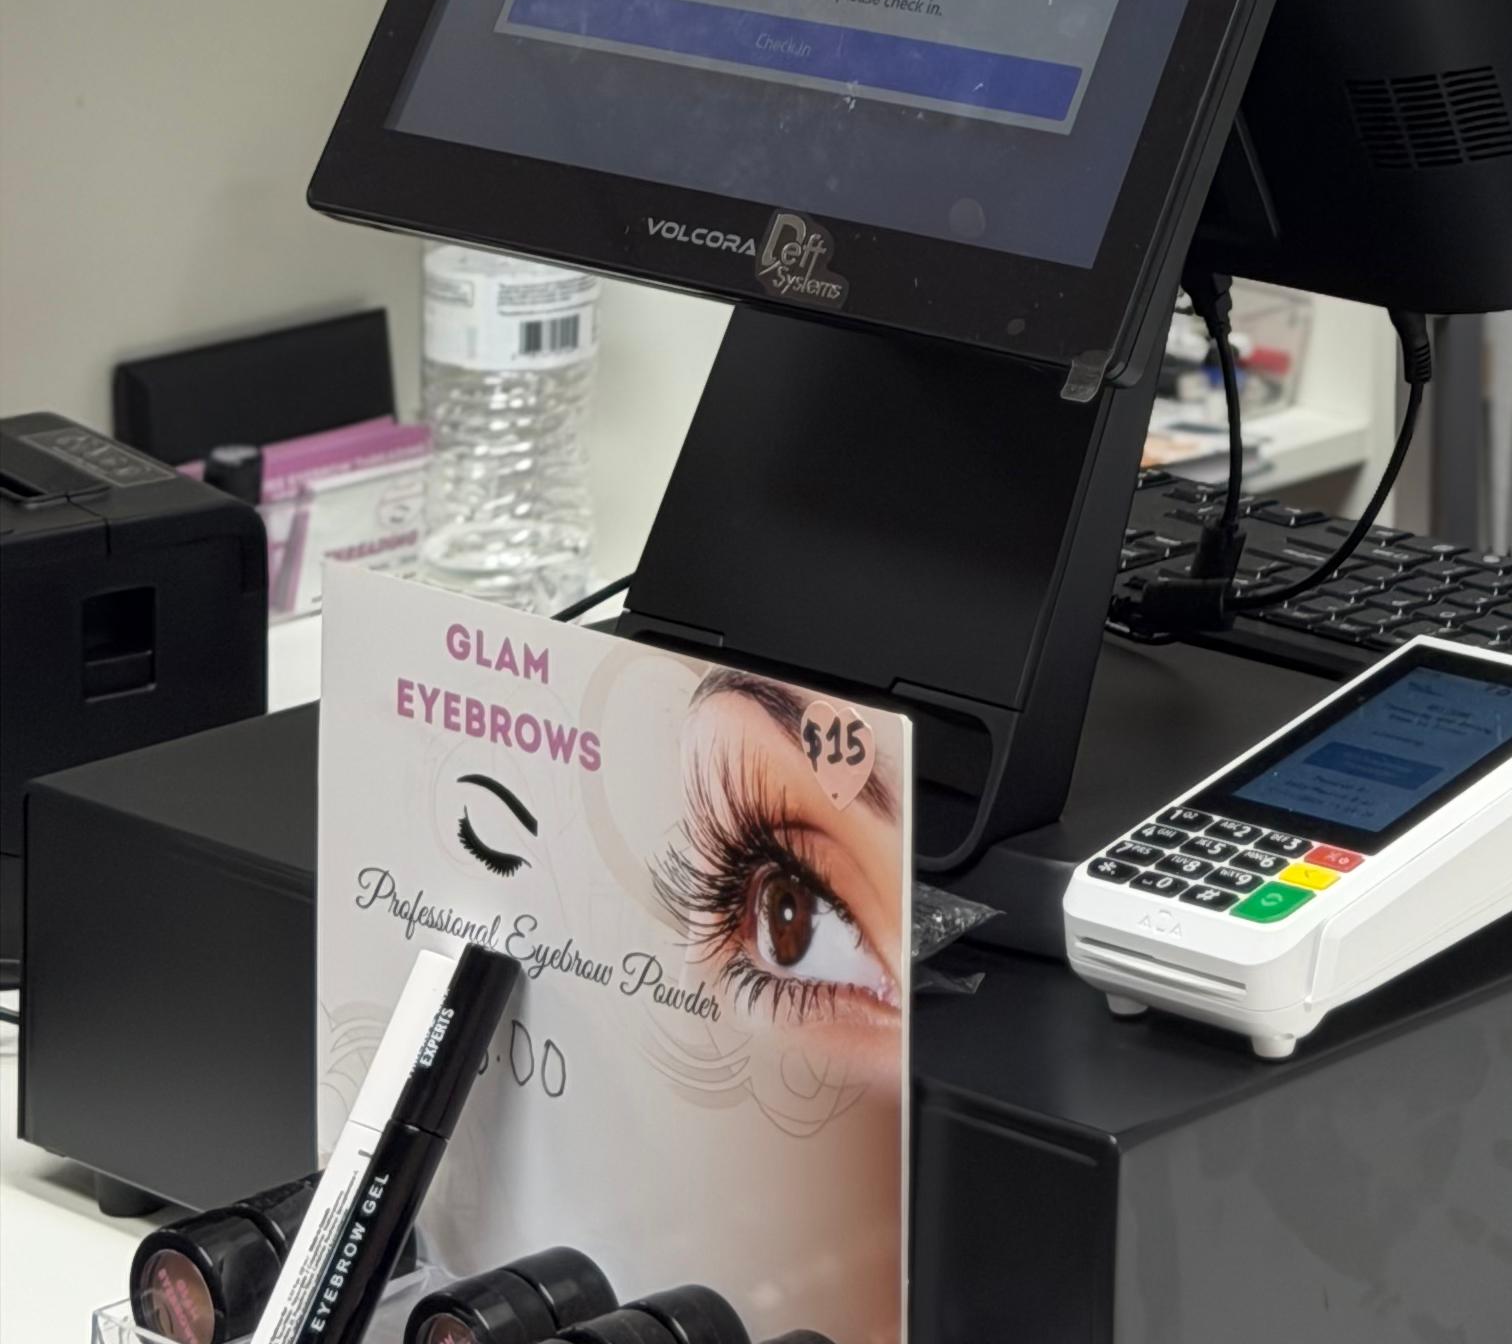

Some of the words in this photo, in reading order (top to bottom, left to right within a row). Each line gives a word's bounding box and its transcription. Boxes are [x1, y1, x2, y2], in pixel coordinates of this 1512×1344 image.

[926, 0, 943, 17] in.
[647, 216, 757, 257] VOLCORA
[447, 624, 550, 683] GLAM
[397, 678, 601, 771] EYEBROWS
[803, 719, 866, 771] $15
[1234, 825, 1251, 838] 2
[1284, 838, 1302, 850] 3
[1208, 842, 1226, 855] 5
[1259, 856, 1277, 868] 6
[1183, 860, 1200, 872] 8
[1235, 874, 1253, 886] 9
[354, 867, 499, 946] Professional
[504, 915, 613, 986] Eyebrow
[620, 951, 722, 1022] Powder
[420, 1008, 454, 1068] EXPERTS
[310, 1221, 366, 1333] EYEBROW
[362, 1173, 390, 1214] GEL
